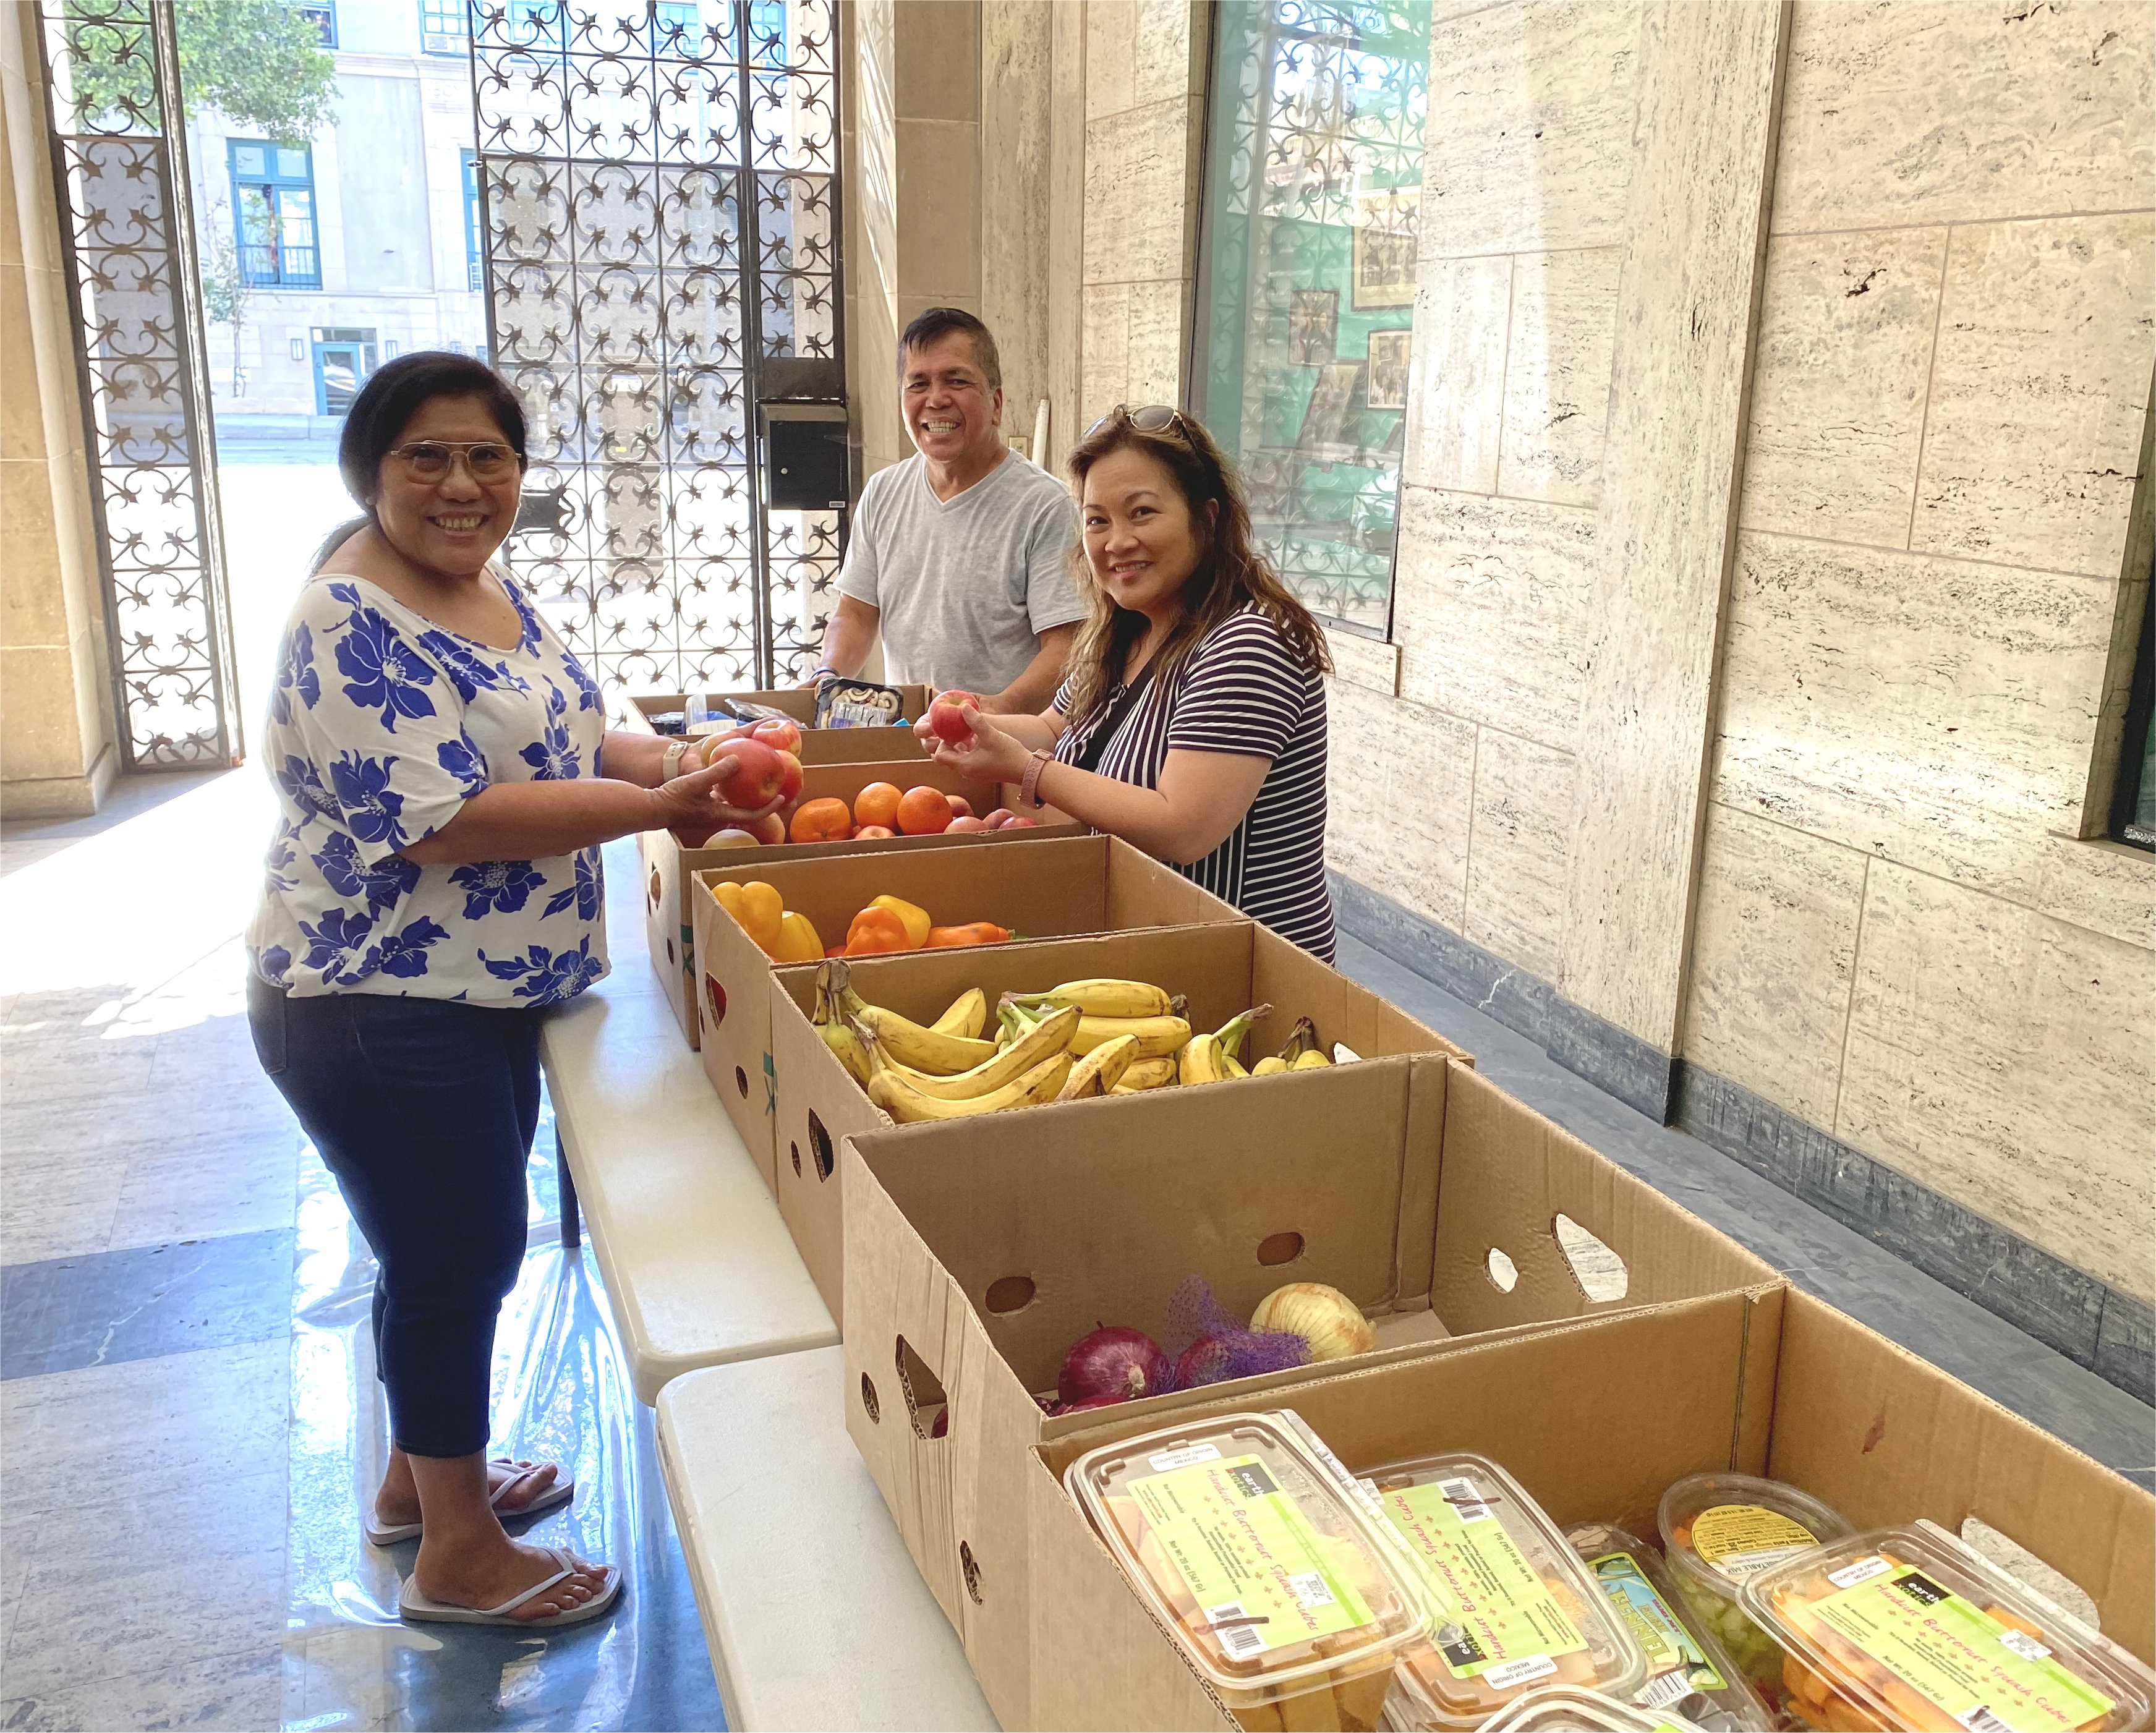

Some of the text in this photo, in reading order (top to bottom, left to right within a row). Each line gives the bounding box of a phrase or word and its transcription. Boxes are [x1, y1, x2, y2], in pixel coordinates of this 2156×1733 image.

[1153, 1455, 1180, 1463] COUNTRY
[1225, 1468, 1253, 1499] exotics
[1241, 1472, 1264, 1495] earth
[1493, 1532, 1503, 1540] Gr)
[1499, 1541, 1513, 1552] (567
[1207, 1470, 1235, 1505] Handcut
[1232, 1509, 1272, 1559] Butternut
[1269, 1564, 1297, 1598] Squash
[1296, 1601, 1318, 1630] Cubes
[1454, 1543, 1466, 1555] product
[1169, 1541, 1178, 1549] Net
[1186, 1571, 1199, 1582] (567
[1195, 1583, 1206, 1591] Gr)
[1726, 1565, 1741, 1574] MIX
[1833, 1570, 1856, 1581] COUNTRY
[1864, 1560, 1881, 1569] ORIGIN
[1853, 1570, 1873, 1579] MEXICO
[1395, 1495, 1506, 1659] Handcut Butternut Squash Cubes
[1523, 1573, 1533, 1582] Net
[1891, 1581, 1931, 1608] exotics
[1908, 1582, 1940, 1603] earth
[1608, 1584, 1670, 1663] FENNEL
[1875, 1585, 1921, 1617] Handcut
[1923, 1619, 1987, 1663] Butternut
[1991, 1666, 2033, 1697] Squash
[2035, 1697, 2071, 1724] Cubes
[1506, 1662, 1529, 1672] MEXICO
[1523, 1663, 1552, 1674] COUNTRY
[1881, 1654, 1893, 1663] Net
[1917, 1682, 1934, 1692] (567
[1491, 1674, 1514, 1684] ORIGIN
